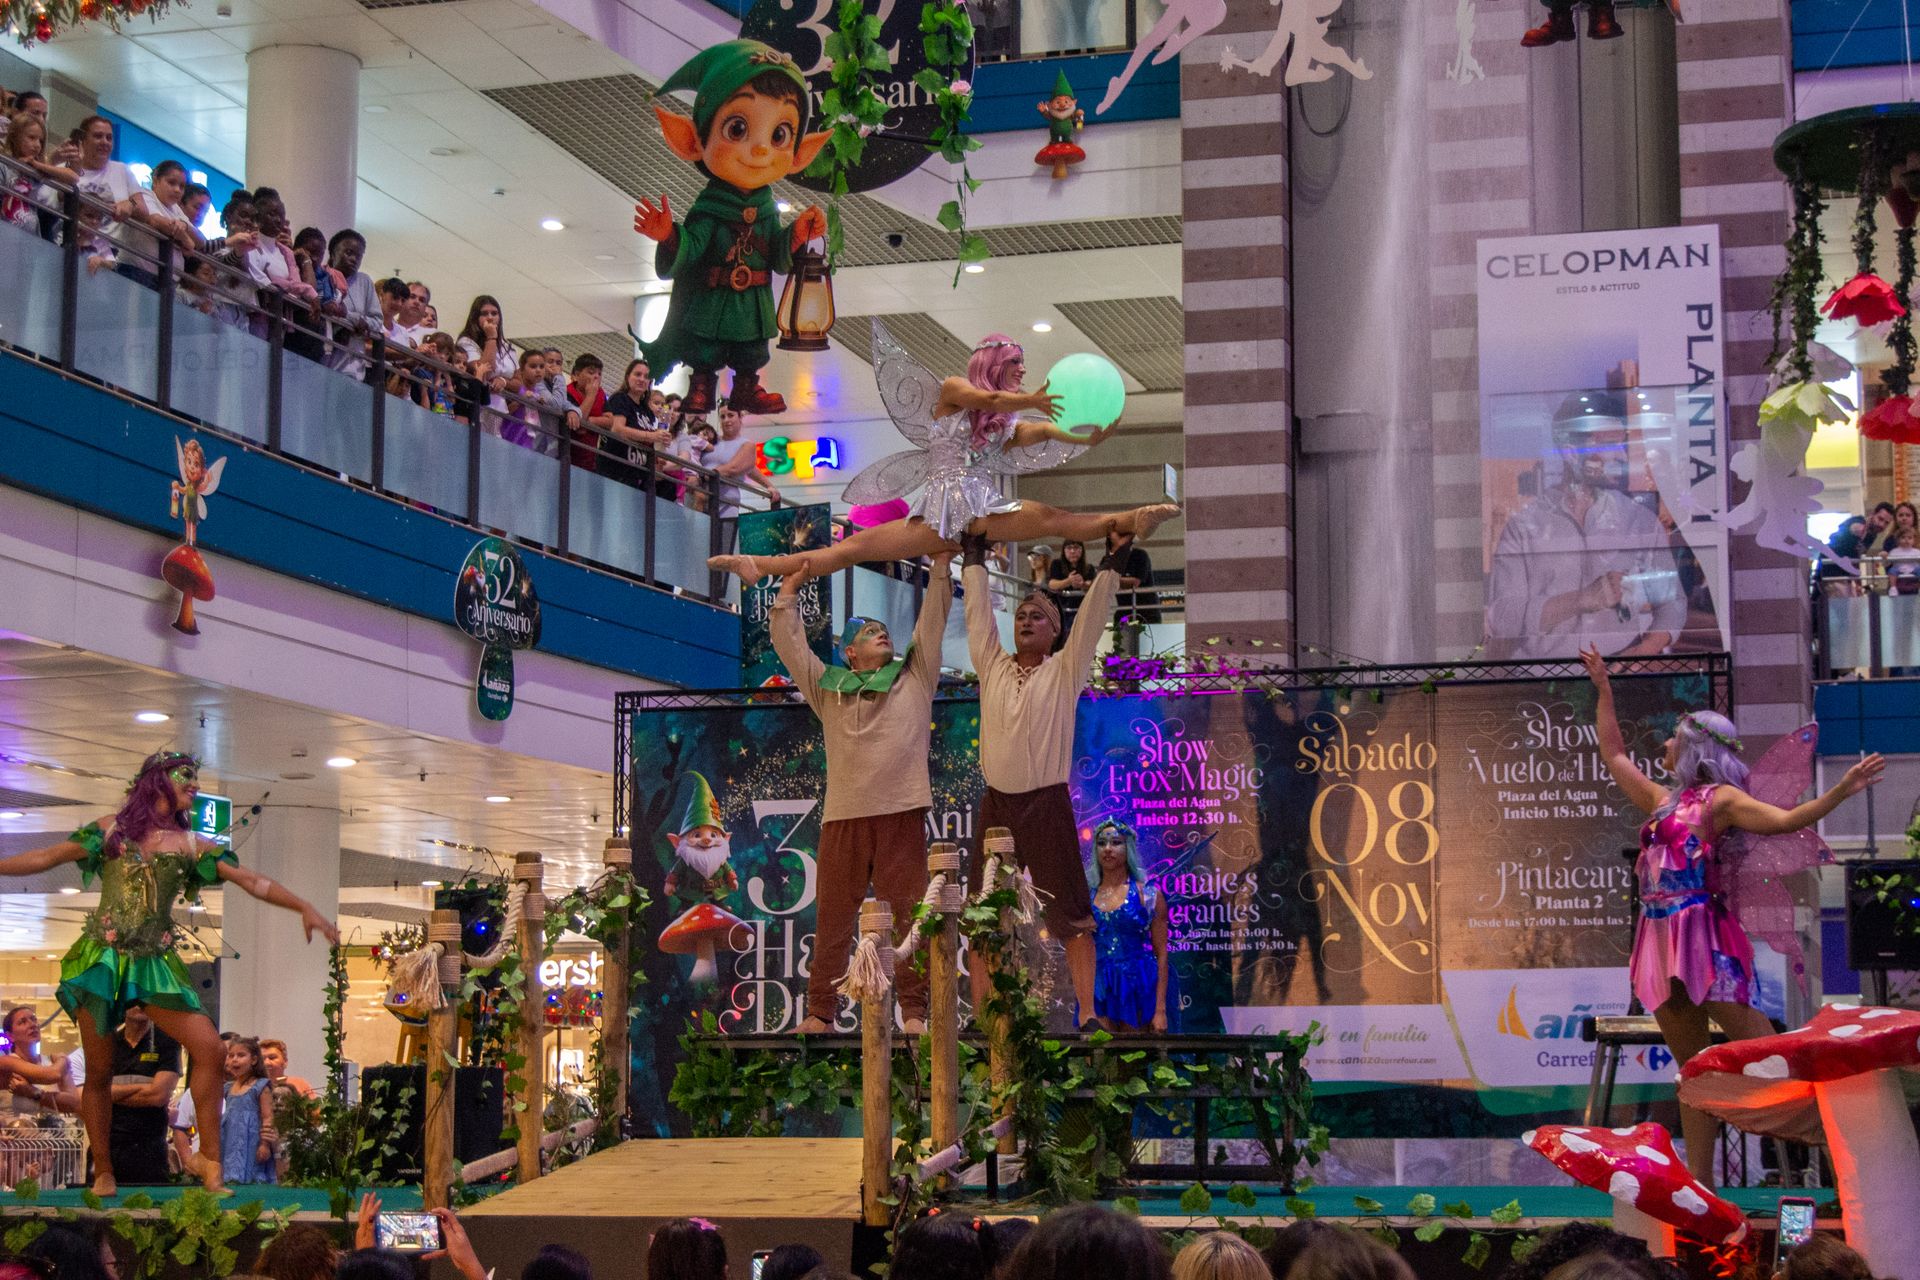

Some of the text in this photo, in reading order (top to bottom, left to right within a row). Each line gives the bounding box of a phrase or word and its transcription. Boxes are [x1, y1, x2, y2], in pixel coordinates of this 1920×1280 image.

[1486, 243, 1710, 280] CELOPMAN
[1556, 286, 1588, 295] ESTILO
[1600, 282, 1641, 292] ACTITUD
[1686, 303, 1717, 488] PLANTA
[484, 550, 517, 609] 32
[467, 600, 531, 641] Aniversario
[1518, 703, 1600, 749] Show
[1131, 719, 1213, 767] Show
[1295, 712, 1437, 776] Sábado
[1108, 762, 1264, 801] Erox Magic
[1467, 748, 1668, 786] Vuelo de Haas
[1132, 796, 1222, 810] Plaza del Agua
[1497, 788, 1598, 802] Plaza del Agua
[1136, 811, 1243, 826] Inicio 12:30 h.
[1309, 780, 1441, 866] 08
[1503, 804, 1618, 820] Inicio 18:30 h.
[1168, 903, 1261, 925] erantes
[1535, 895, 1604, 910] Planta 2
[1188, 928, 1217, 938] hasta
[1219, 928, 1236, 938] las
[1238, 927, 1270, 937] 13:00
[1298, 869, 1441, 974] Nov
[1468, 919, 1502, 929] Desde
[1504, 918, 1521, 928] las
[1524, 917, 1556, 927] 17:00
[1573, 917, 1604, 926] hasta
[1606, 917, 1624, 926] las
[1206, 941, 1234, 951] hasta
[1236, 940, 1252, 950] las
[1254, 940, 1285, 950] 19:30
[1339, 1030, 1361, 1043] en
[1363, 1024, 1430, 1054] familia
